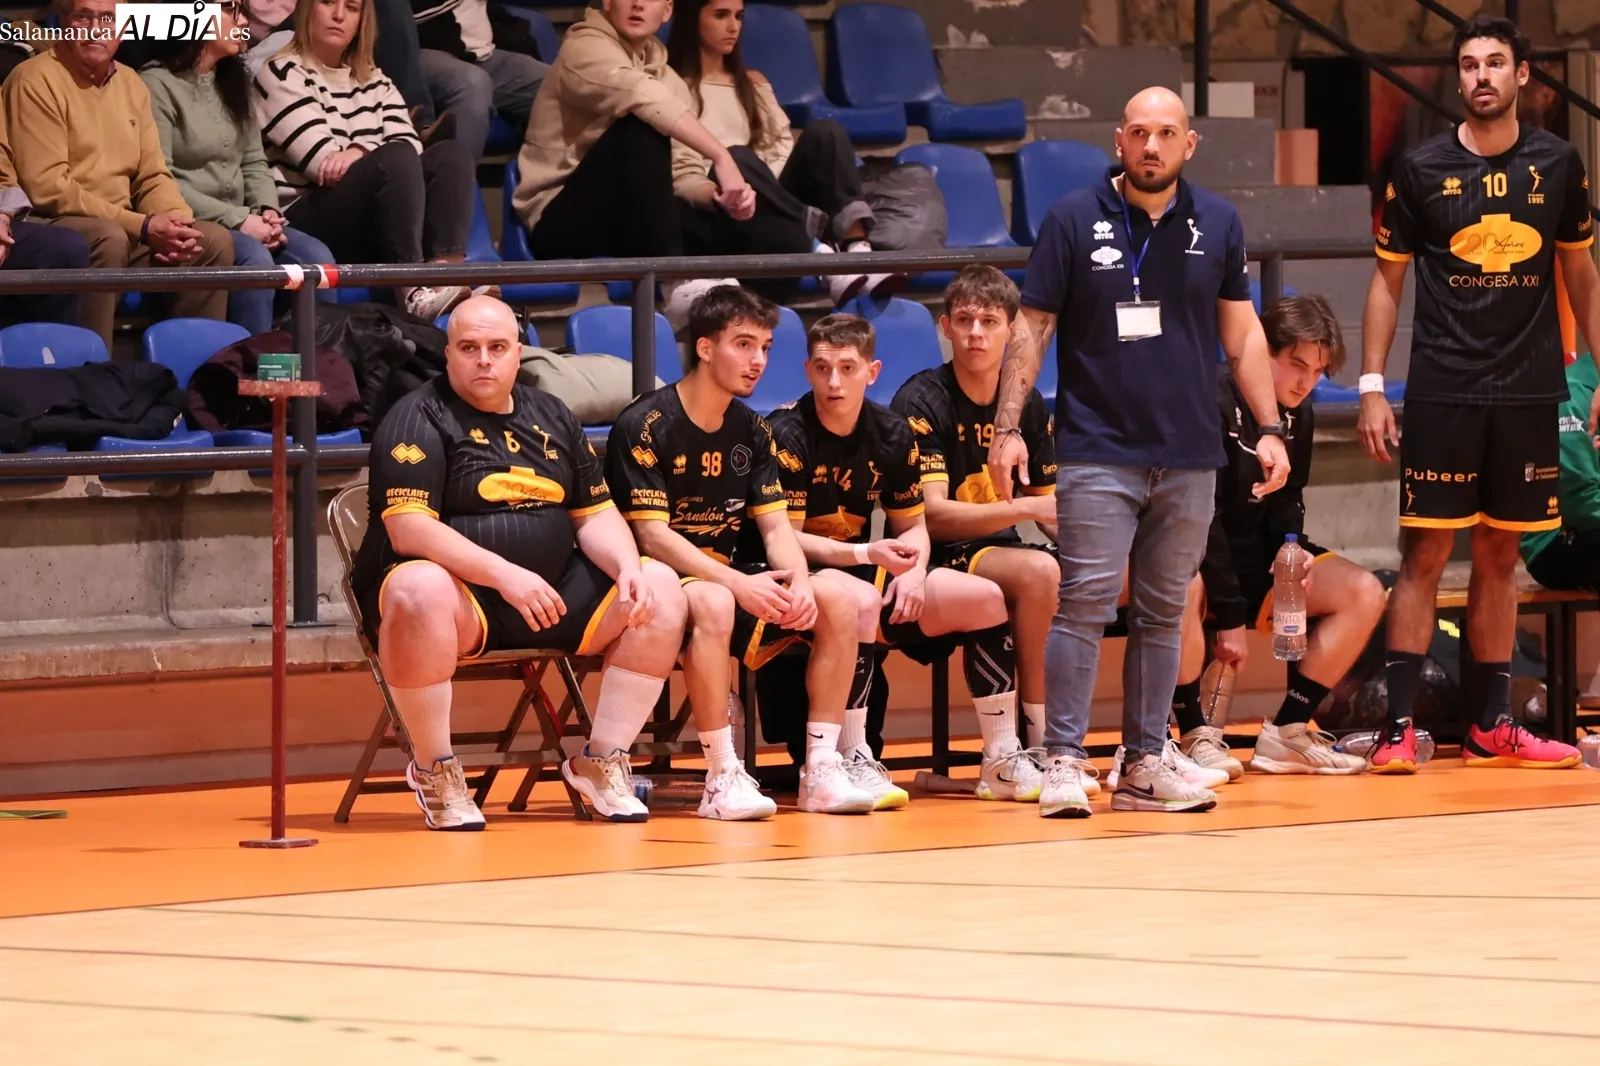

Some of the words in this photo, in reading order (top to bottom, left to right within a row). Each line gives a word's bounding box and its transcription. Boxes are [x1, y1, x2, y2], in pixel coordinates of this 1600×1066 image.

[1482, 172, 1507, 198] 10
[1449, 275, 1518, 287] CONGESA
[1522, 275, 1540, 287] XXI
[503, 431, 521, 453] 6
[974, 423, 995, 448] 19
[701, 451, 722, 477] 98
[1405, 468, 1477, 482] Pubeer
